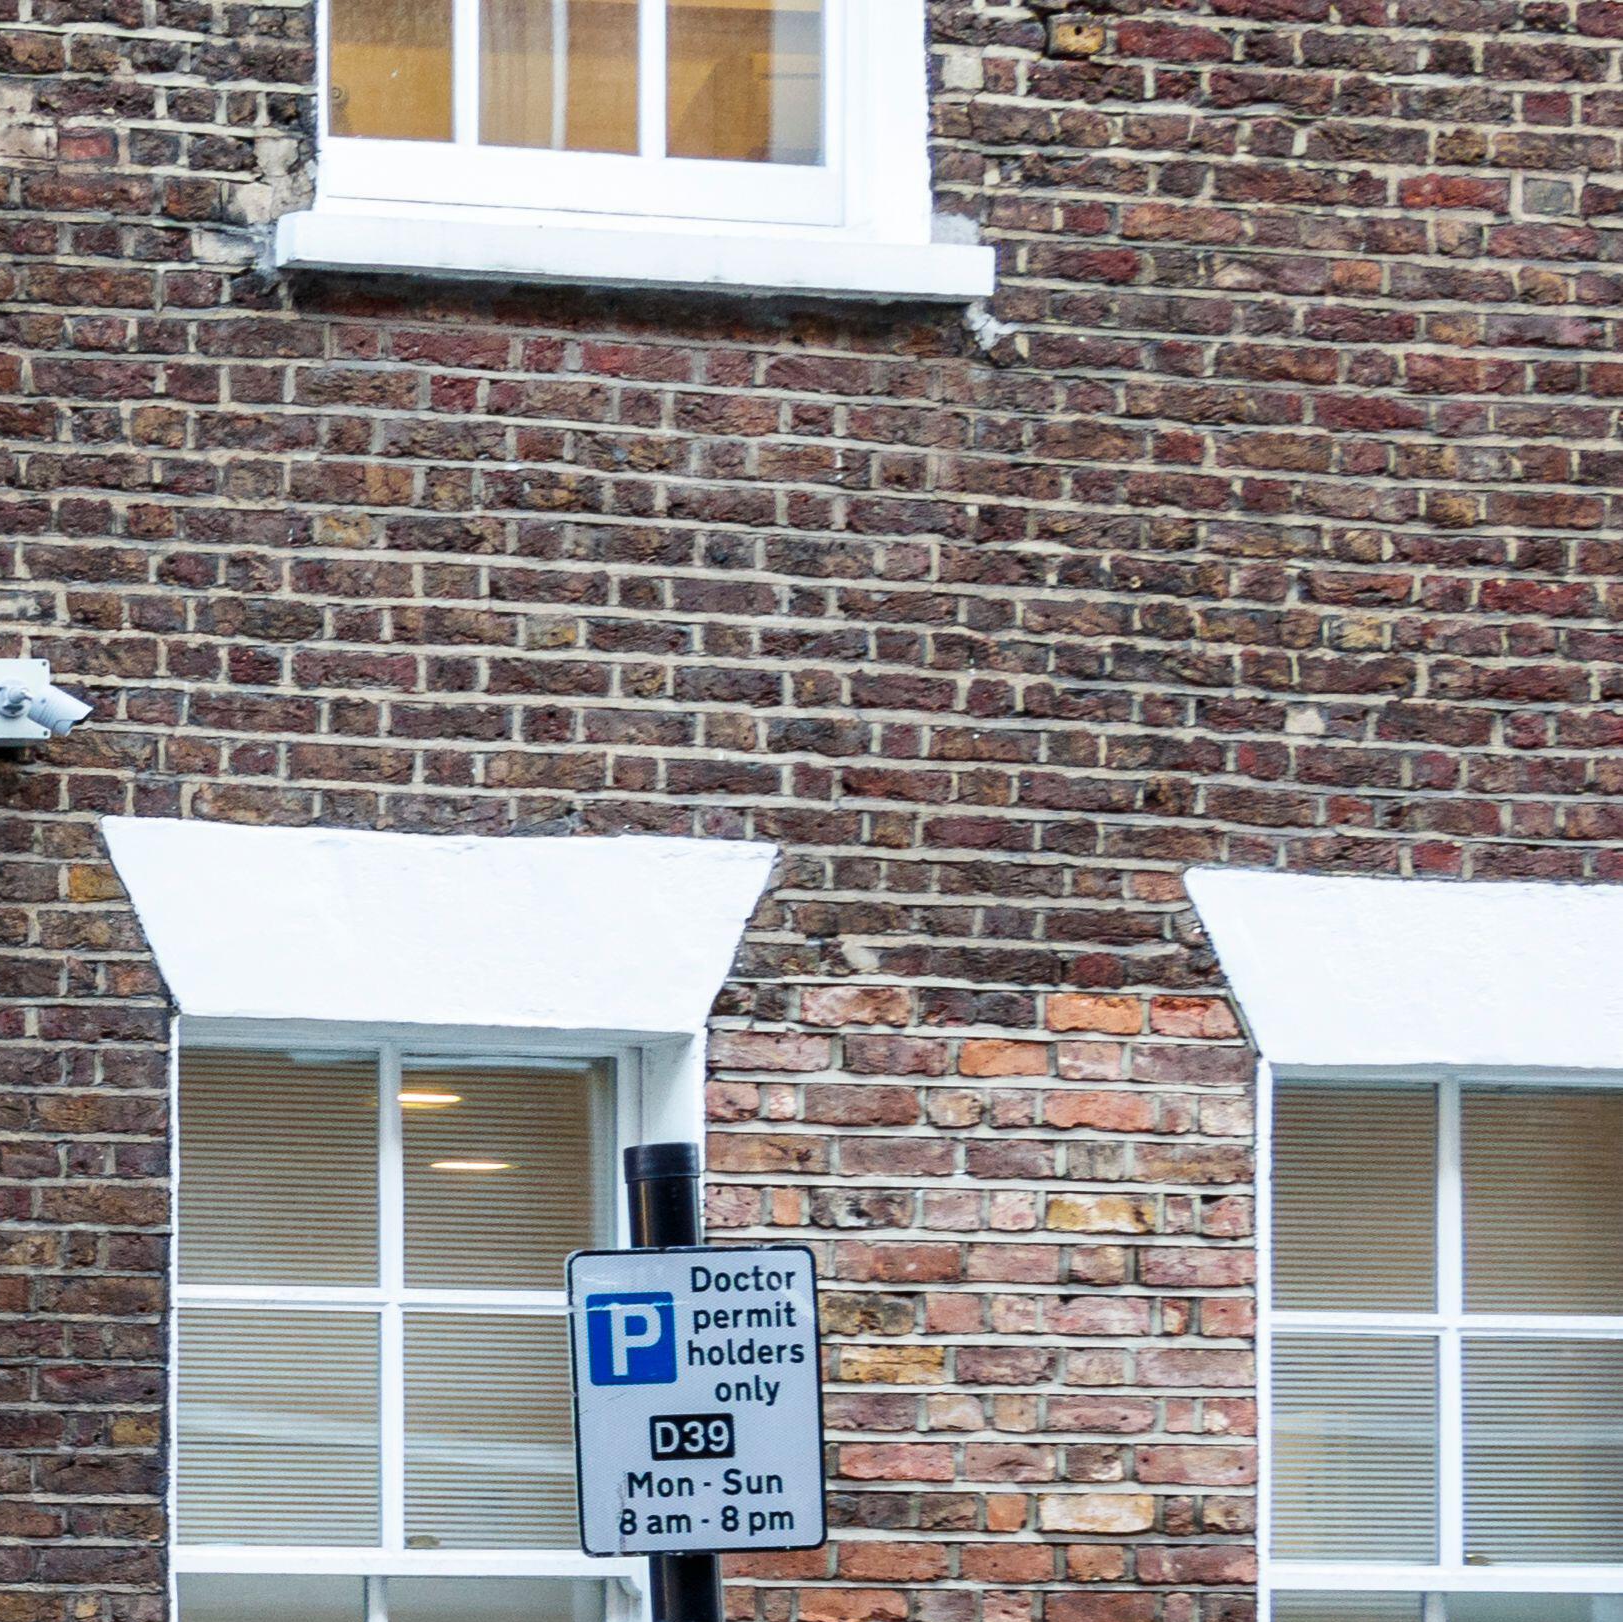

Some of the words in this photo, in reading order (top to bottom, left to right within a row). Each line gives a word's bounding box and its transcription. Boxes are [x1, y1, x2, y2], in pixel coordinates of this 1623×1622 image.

[691, 1266, 796, 1292] Doctor
[693, 1301, 796, 1334] permit
[610, 1302, 662, 1376] P
[688, 1338, 805, 1366] holders
[715, 1374, 780, 1407] only
[655, 1420, 730, 1454] D39
[627, 1471, 694, 1498] Mon
[723, 1468, 783, 1495] Sun
